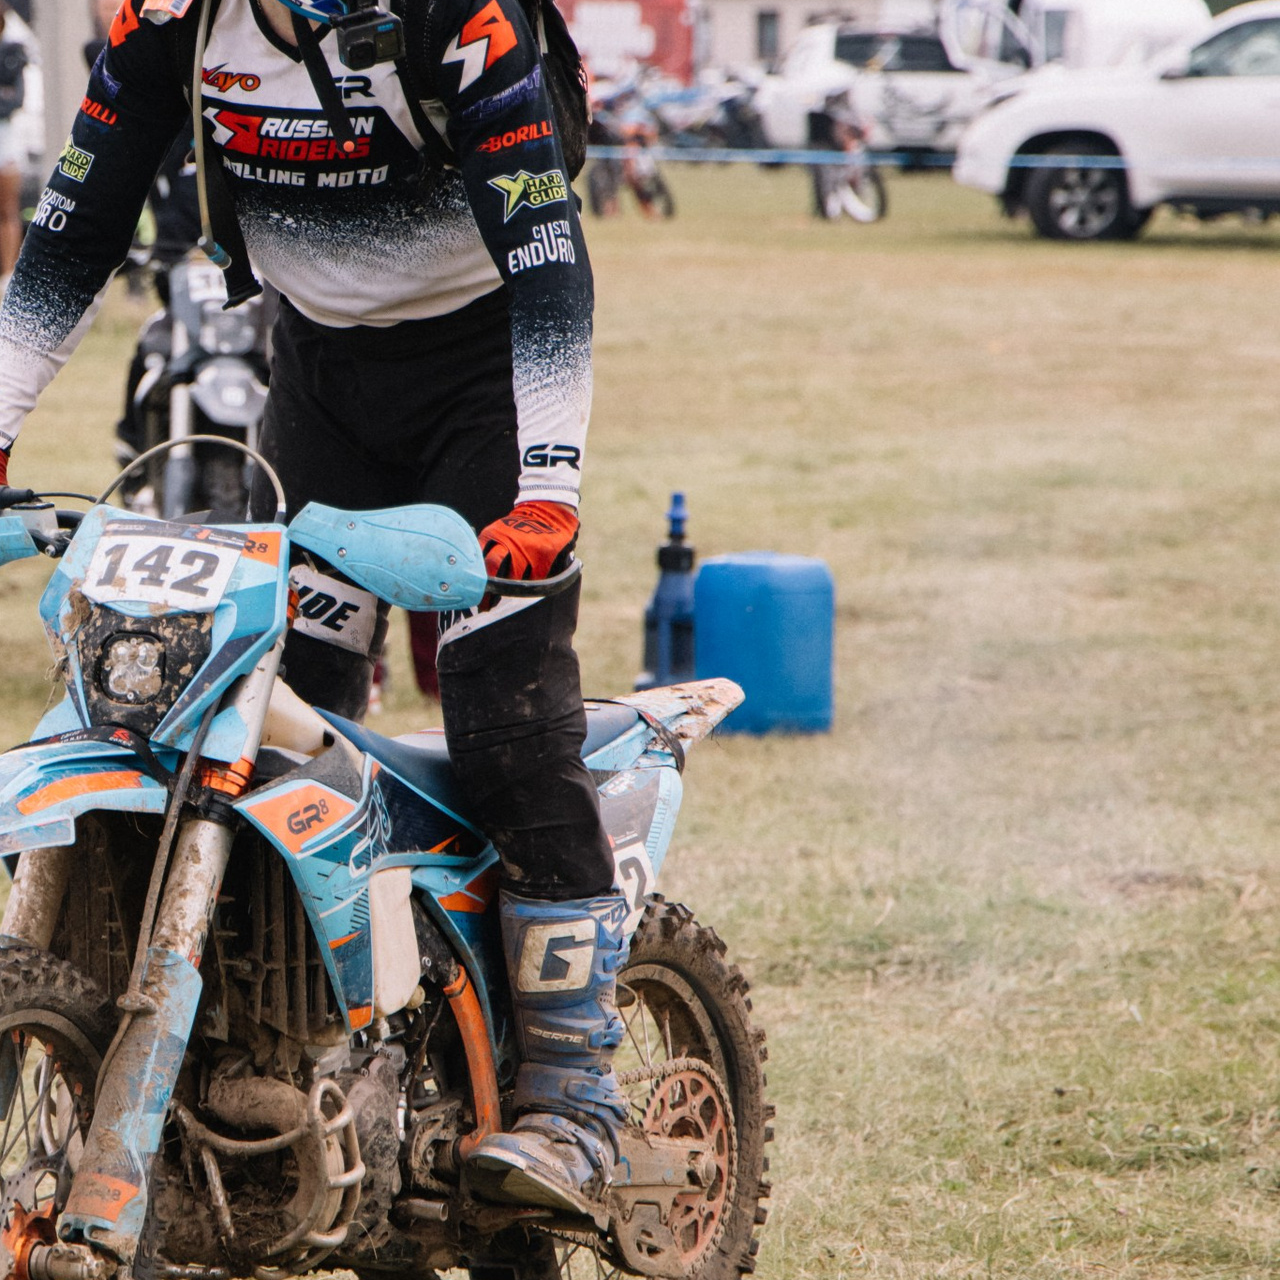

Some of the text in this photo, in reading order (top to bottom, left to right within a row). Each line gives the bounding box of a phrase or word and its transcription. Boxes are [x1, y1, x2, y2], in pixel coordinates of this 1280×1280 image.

[201, 62, 261, 93] KAYO
[477, 120, 552, 153] BORILL
[223, 155, 389, 188] ROLLING MOTO
[526, 174, 564, 192] HARD
[530, 187, 568, 205] GLIDE
[508, 229, 576, 275] ENDURO
[523, 443, 581, 471] GR
[96, 543, 220, 597] 142
